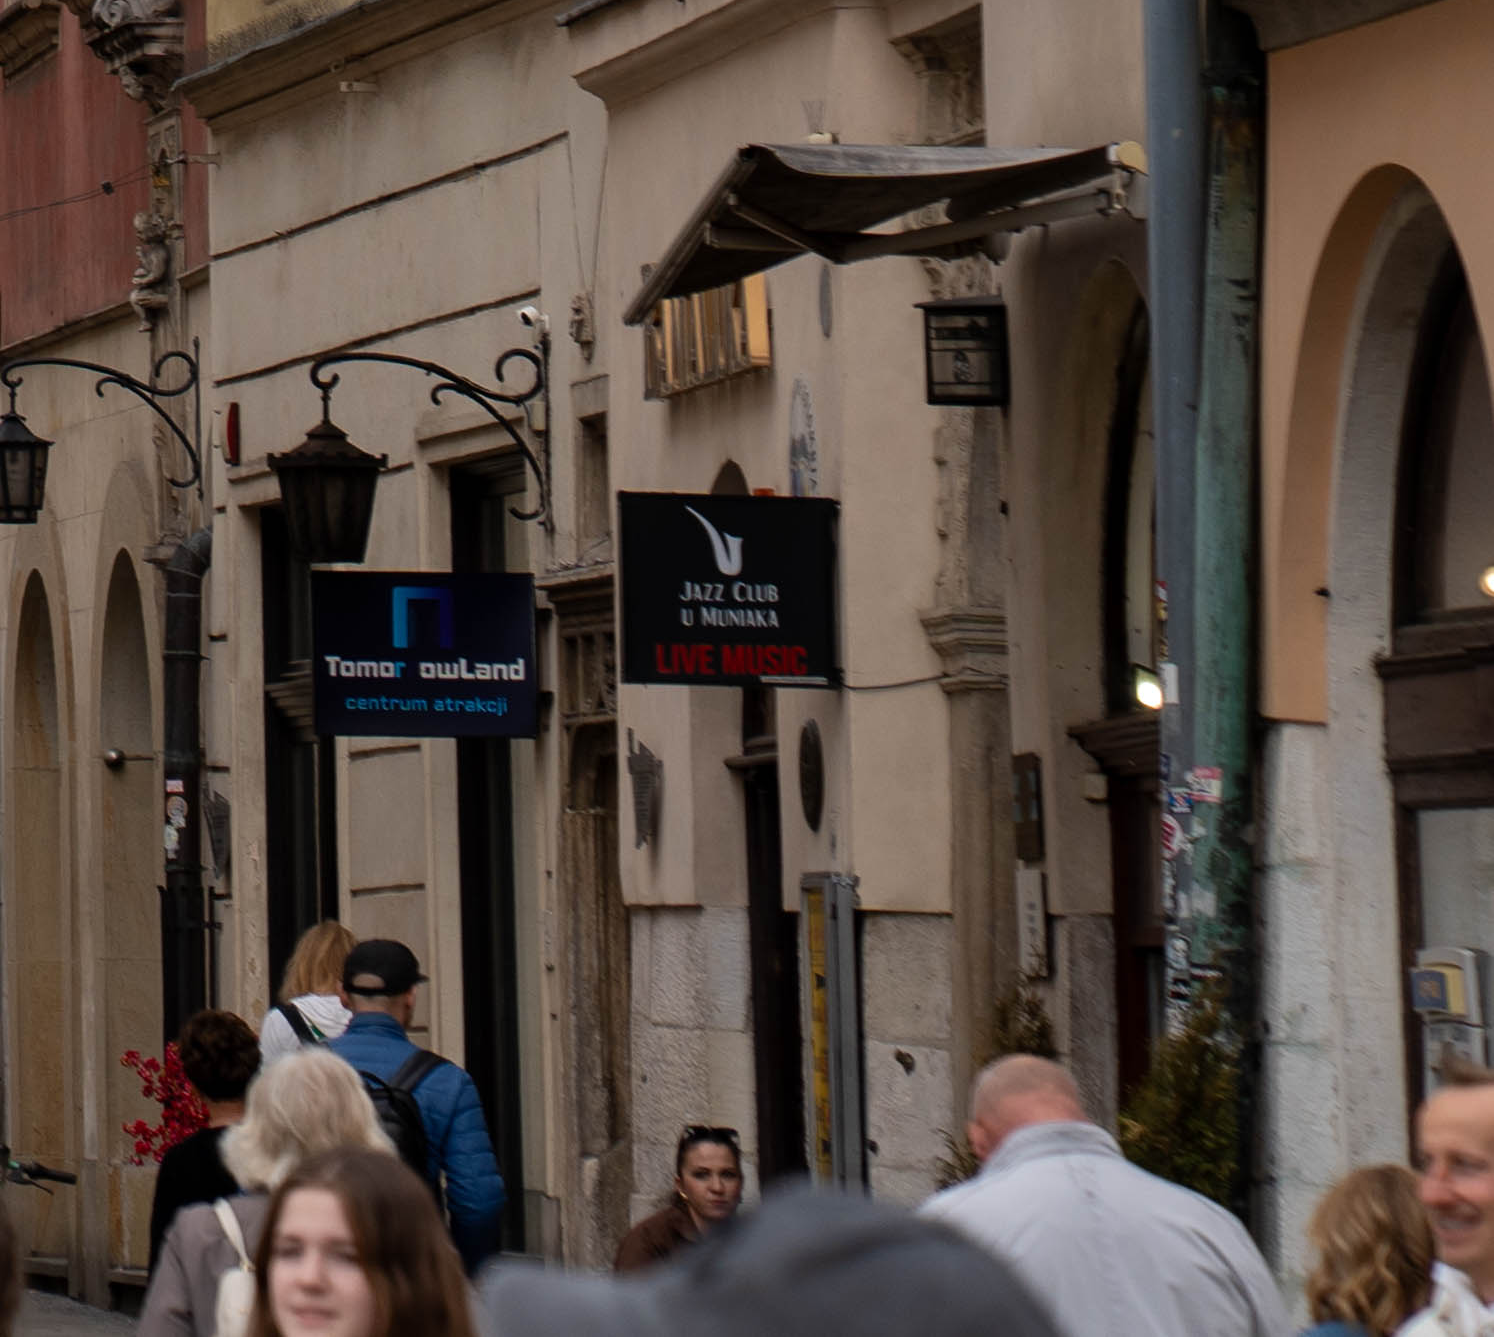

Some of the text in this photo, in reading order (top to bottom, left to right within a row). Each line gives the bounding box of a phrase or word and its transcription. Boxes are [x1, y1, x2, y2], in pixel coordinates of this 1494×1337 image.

[679, 581, 780, 604] JAZZ CLUB
[701, 607, 780, 629] MUNIAKA
[656, 644, 808, 677] LIVE MUSIC
[345, 694, 508, 717] centrum atrakcji
